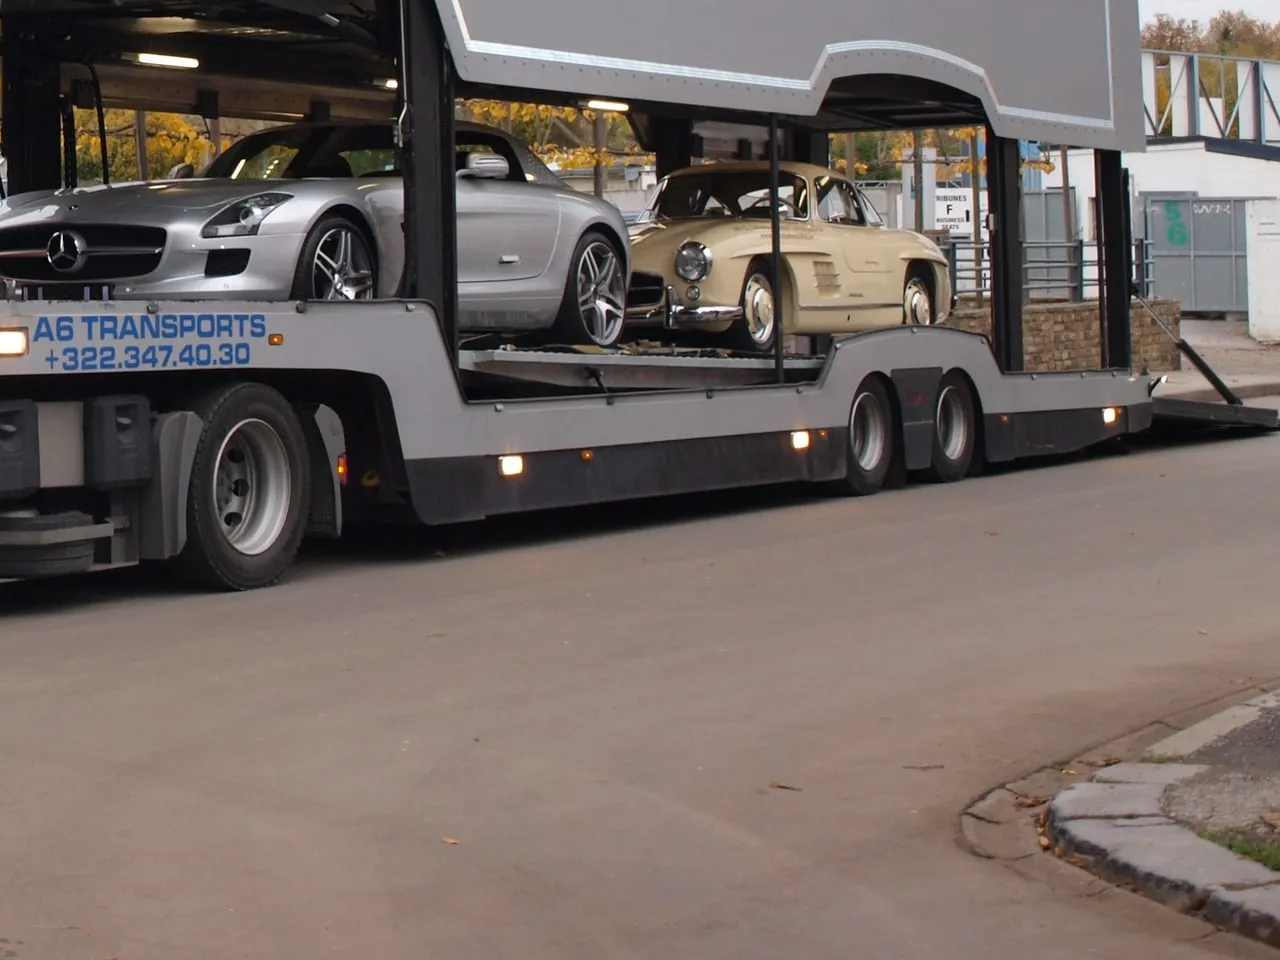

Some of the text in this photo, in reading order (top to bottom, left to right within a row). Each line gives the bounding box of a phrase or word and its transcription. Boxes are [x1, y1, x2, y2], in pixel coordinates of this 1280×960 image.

[946, 204, 953, 215] F
[33, 314, 266, 342] A6 TRANSPORTS
[45, 343, 251, 371] +322.347.40.30
